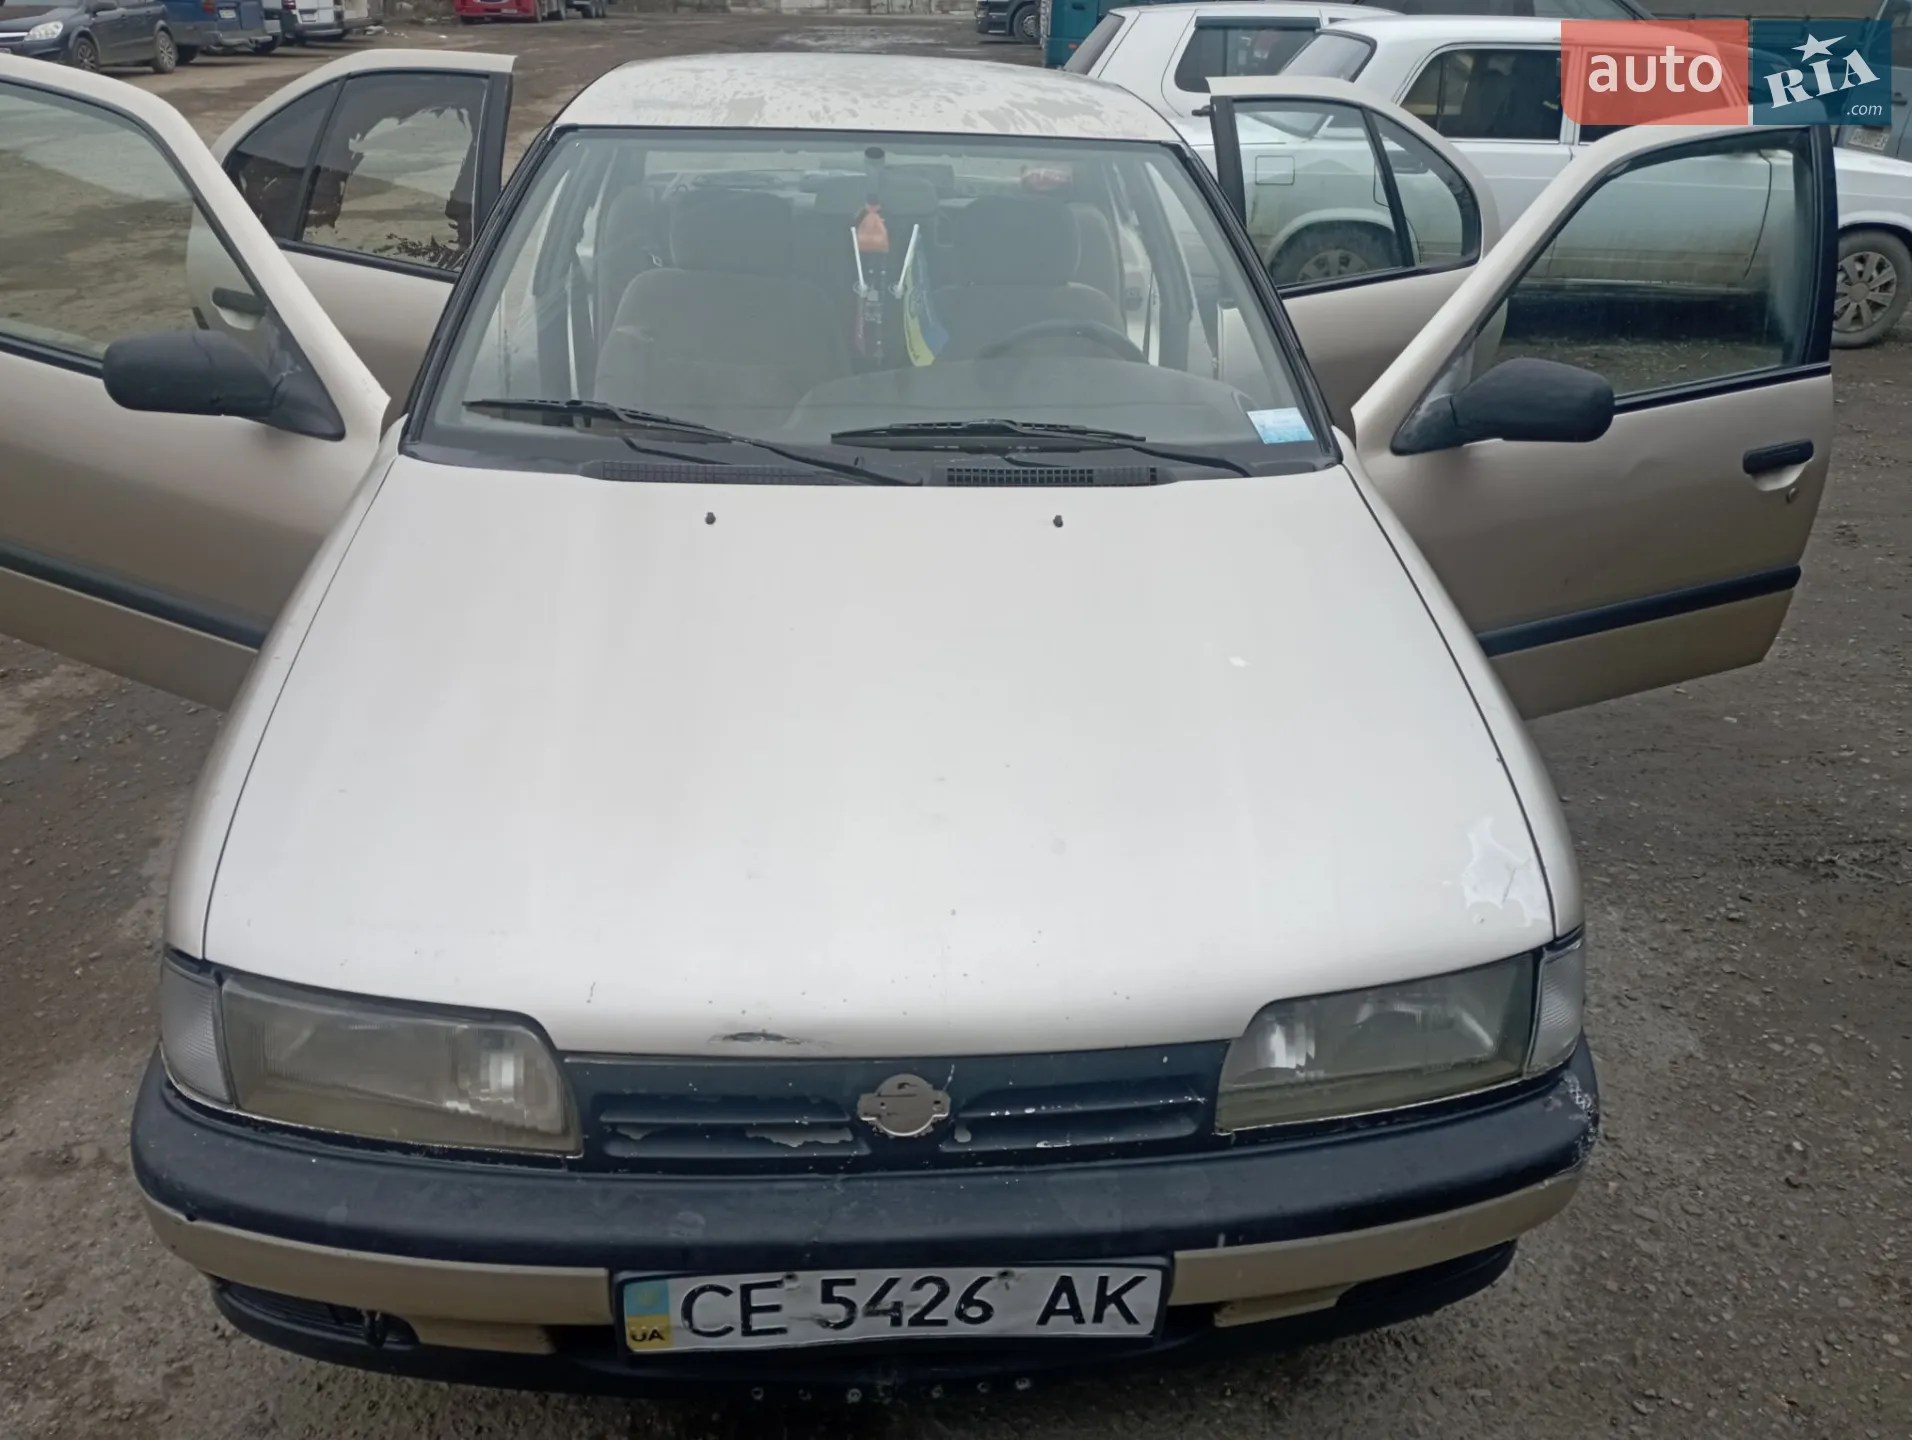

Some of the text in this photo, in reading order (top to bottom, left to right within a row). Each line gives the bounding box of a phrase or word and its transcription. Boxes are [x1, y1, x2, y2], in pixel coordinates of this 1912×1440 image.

[681, 1275, 1148, 1338] CE 5426 AK
[630, 1329, 665, 1342] UA
